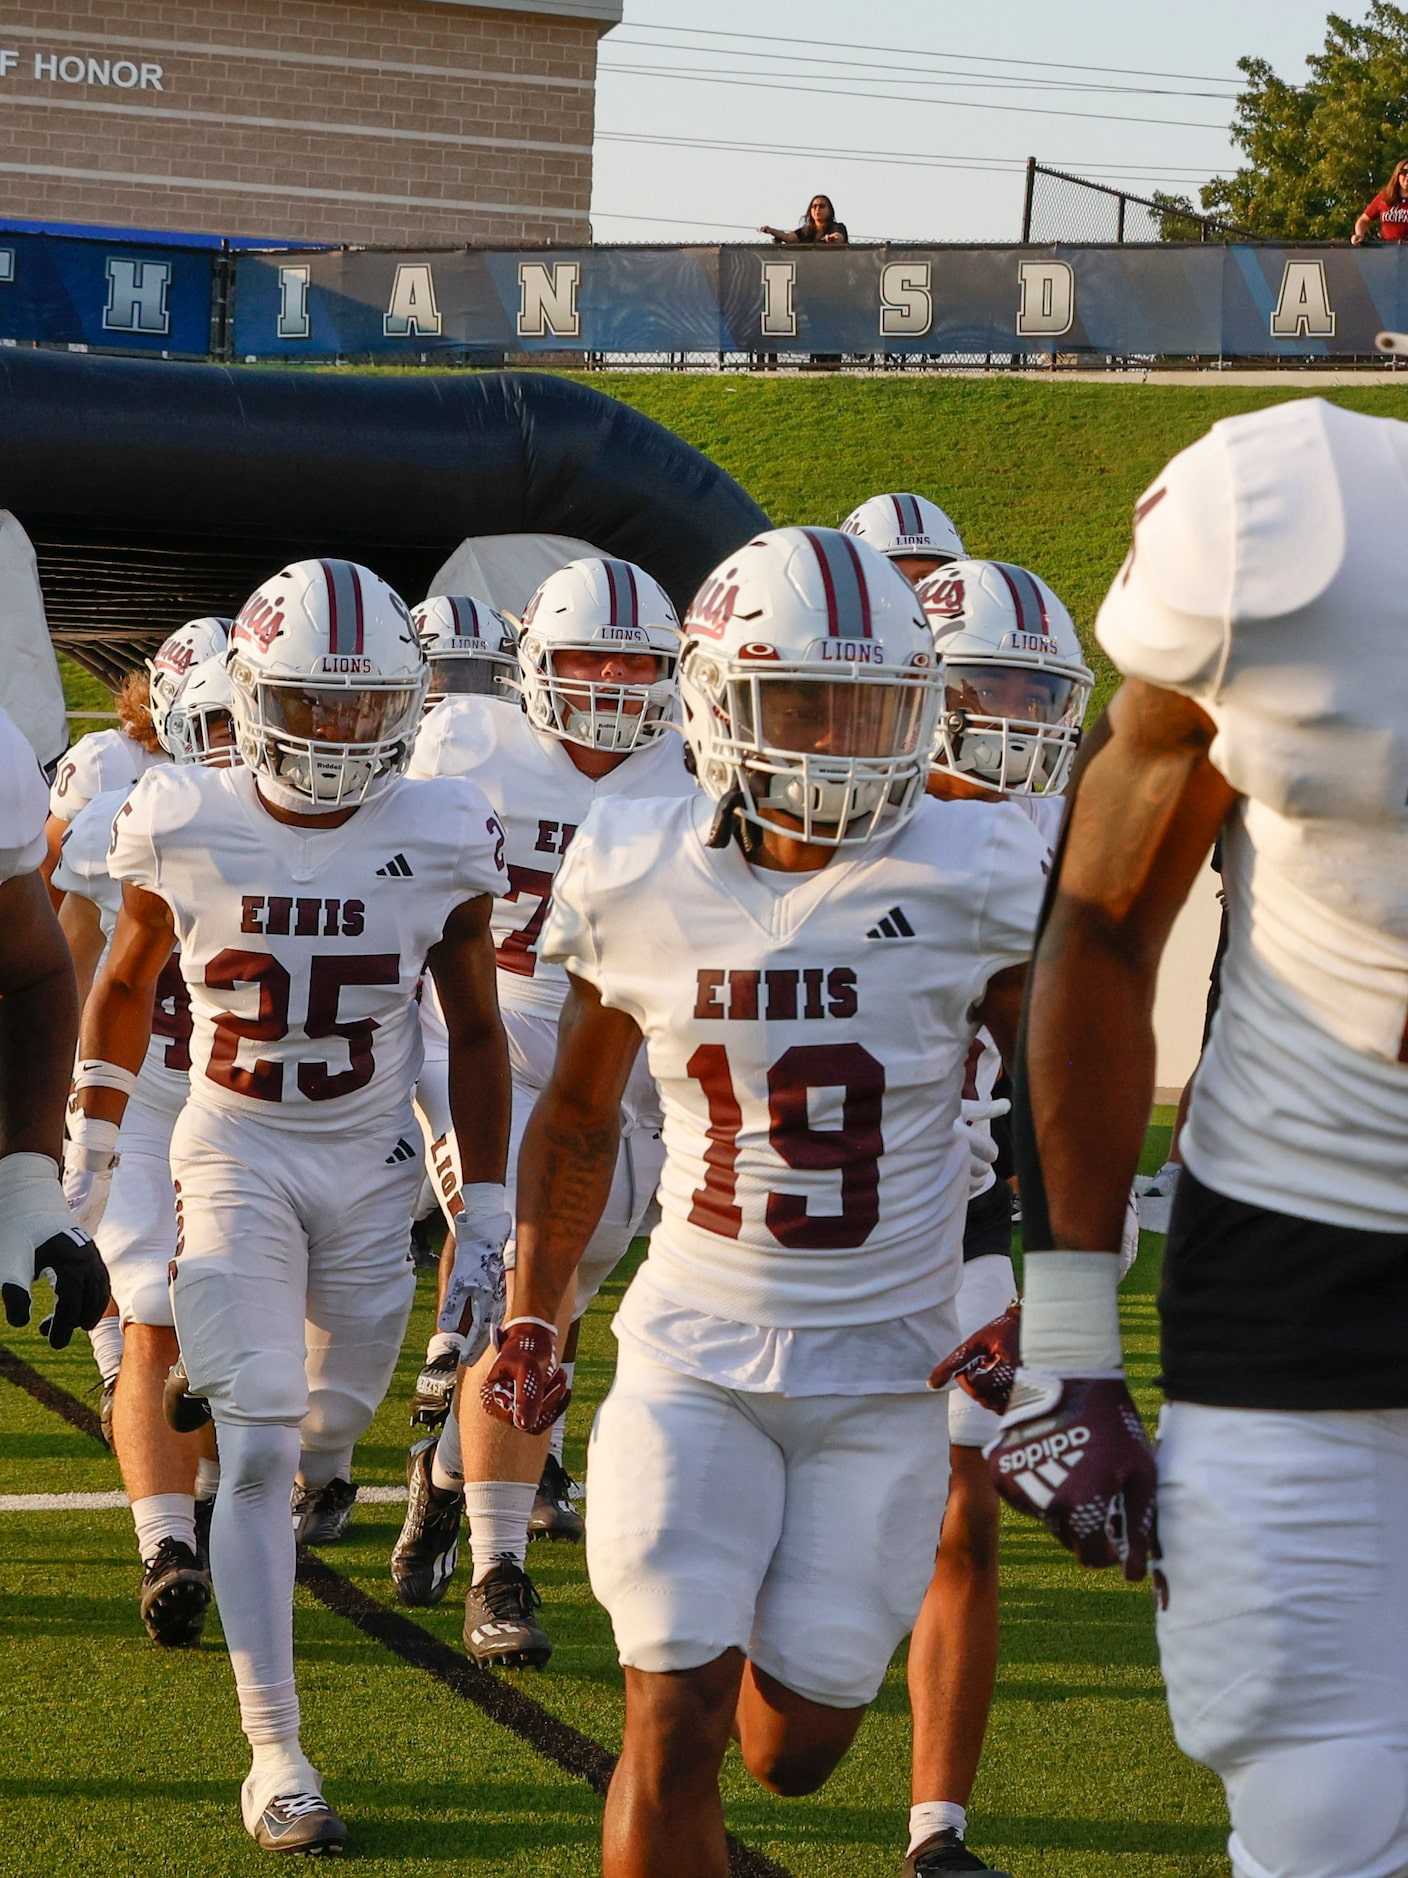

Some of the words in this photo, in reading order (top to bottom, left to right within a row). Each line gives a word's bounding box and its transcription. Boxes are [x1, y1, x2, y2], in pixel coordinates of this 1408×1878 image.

[34, 53, 165, 91] HONOR
[895, 535, 931, 546] LIONS
[451, 638, 488, 650] LIONS
[601, 627, 642, 641] LIONS
[1010, 632, 1060, 655] LIONS
[321, 657, 372, 673] LIONS
[821, 640, 884, 665] LIONS
[240, 895, 365, 937] ENNIS
[692, 966, 859, 1021] ENNIS
[204, 948, 402, 1103] 25
[686, 1042, 886, 1250] 19
[998, 1425, 1092, 1475] adidas
